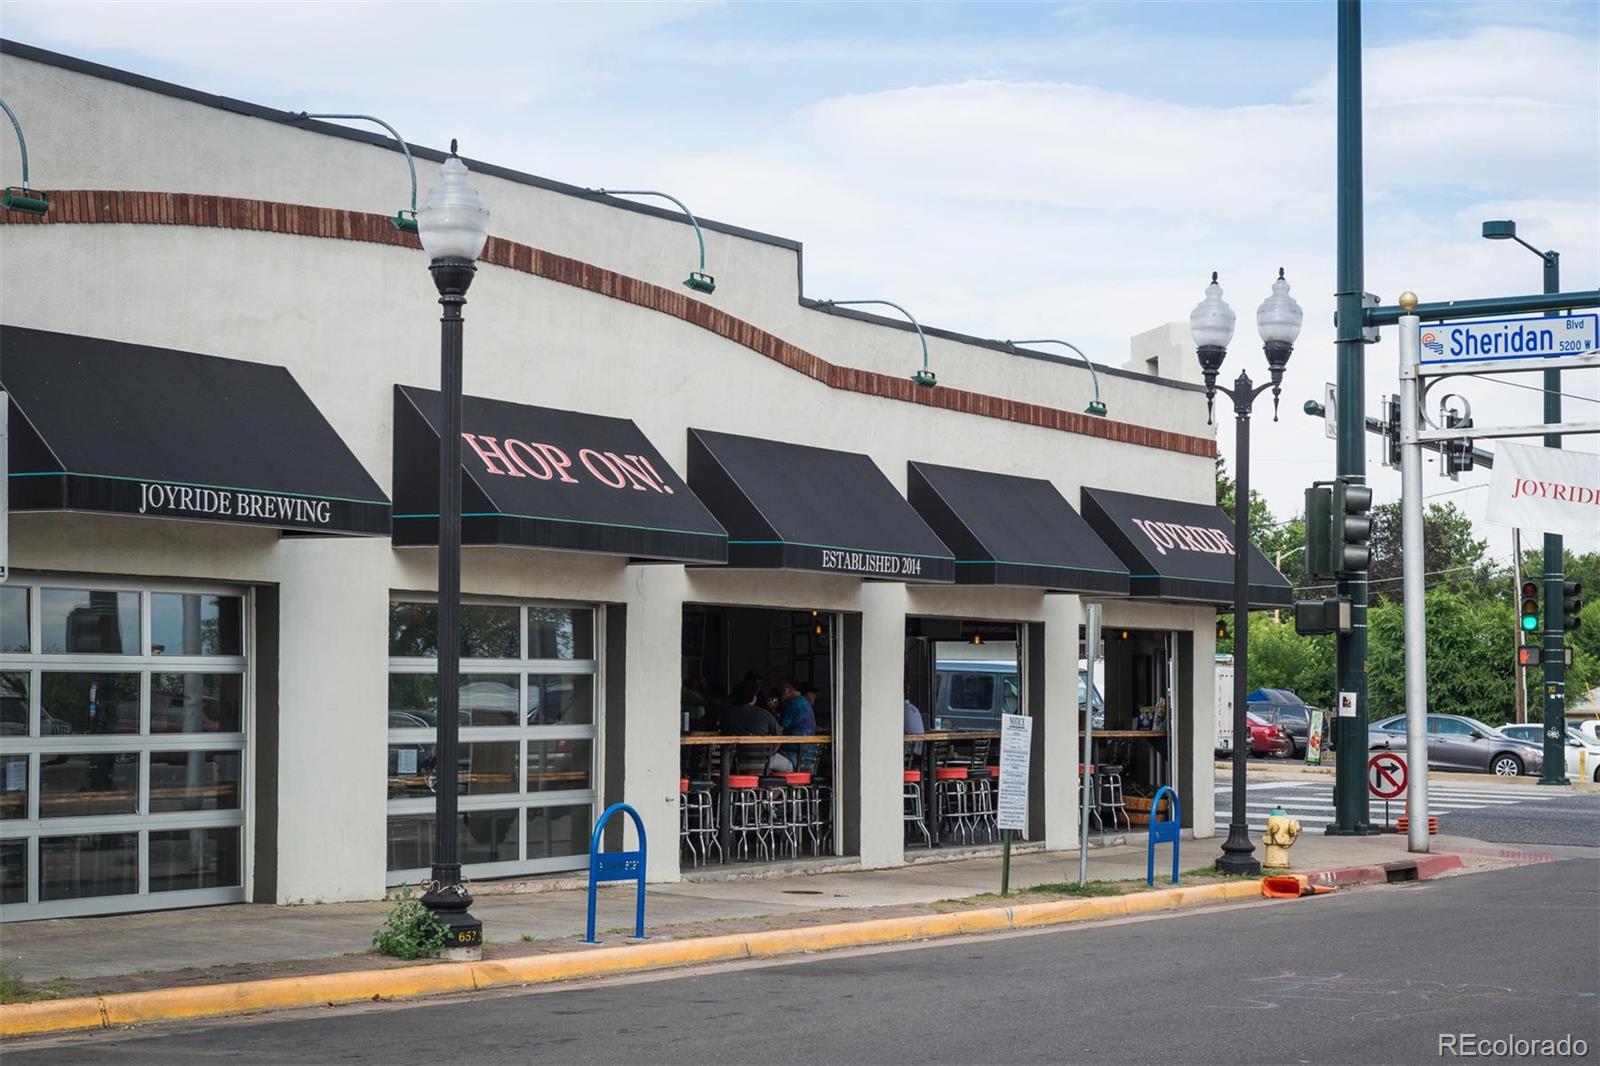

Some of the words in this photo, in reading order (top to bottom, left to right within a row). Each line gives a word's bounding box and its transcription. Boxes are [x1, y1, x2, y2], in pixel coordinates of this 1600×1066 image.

[1450, 325, 1553, 356] Sheridan
[1566, 319, 1585, 331] Blvd
[1559, 340, 1581, 352] 5200
[1584, 339, 1592, 350] W
[461, 432, 579, 485] HOP
[579, 448, 675, 496] ON!
[139, 483, 231, 515] JOYRIDE
[237, 493, 331, 524] BREWING
[821, 549, 900, 574] ESTABLISHED
[901, 557, 921, 576] 2014
[458, 930, 477, 943] 657
